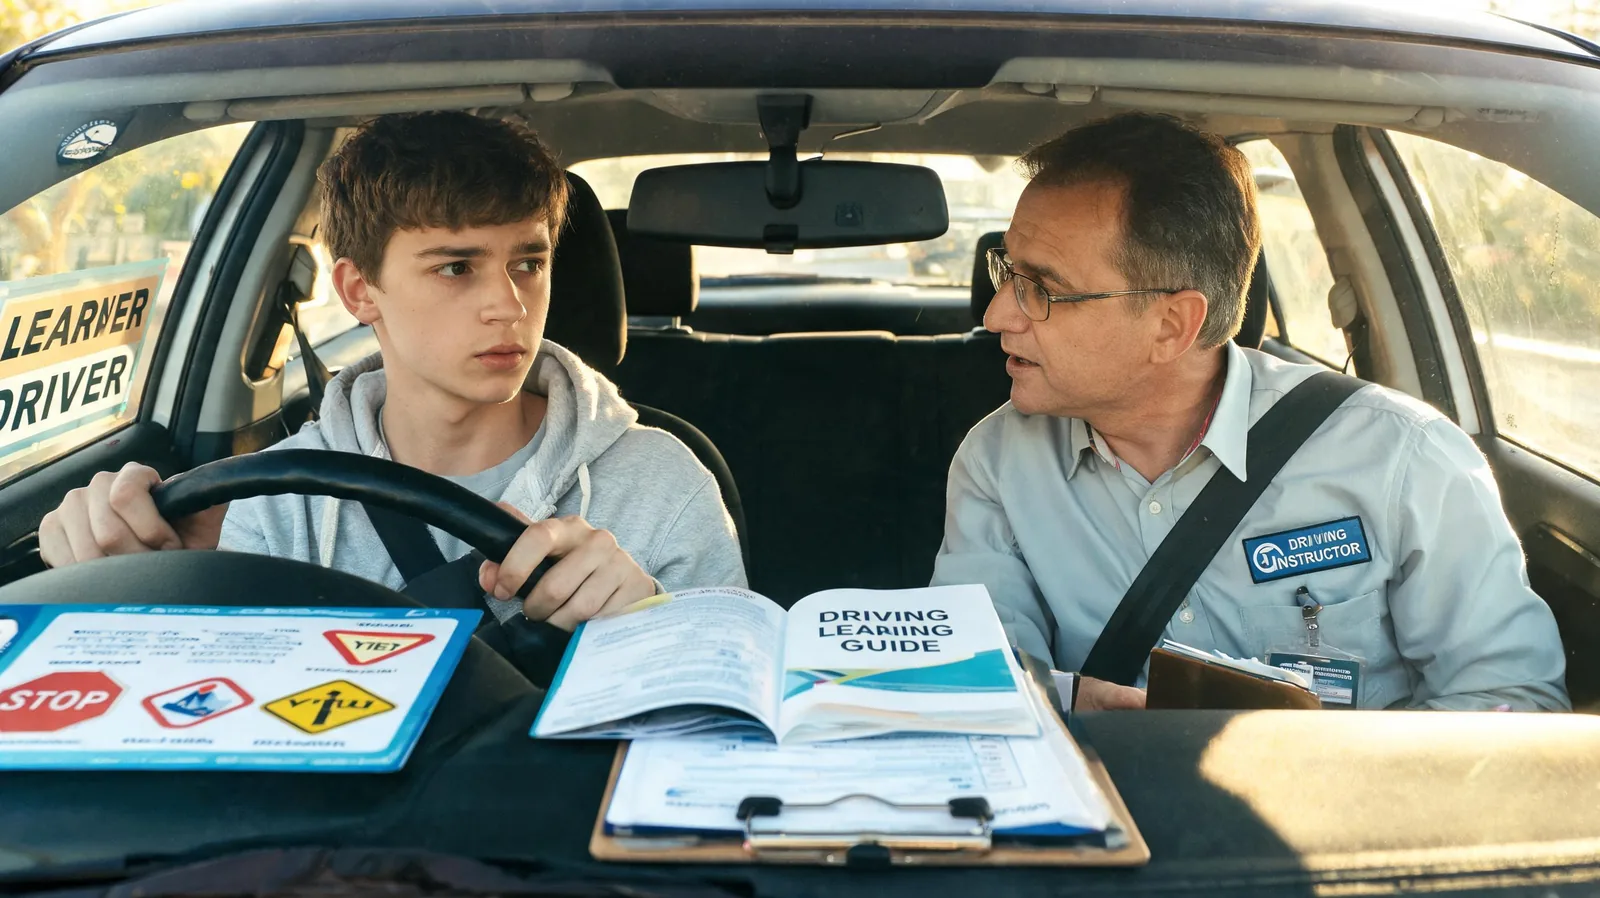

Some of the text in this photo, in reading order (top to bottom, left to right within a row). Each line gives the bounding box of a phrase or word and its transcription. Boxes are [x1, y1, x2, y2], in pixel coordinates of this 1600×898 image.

[819, 609, 949, 623] DRIVING
[840, 639, 941, 652] GUIDE
[0, 689, 110, 711] STOP
